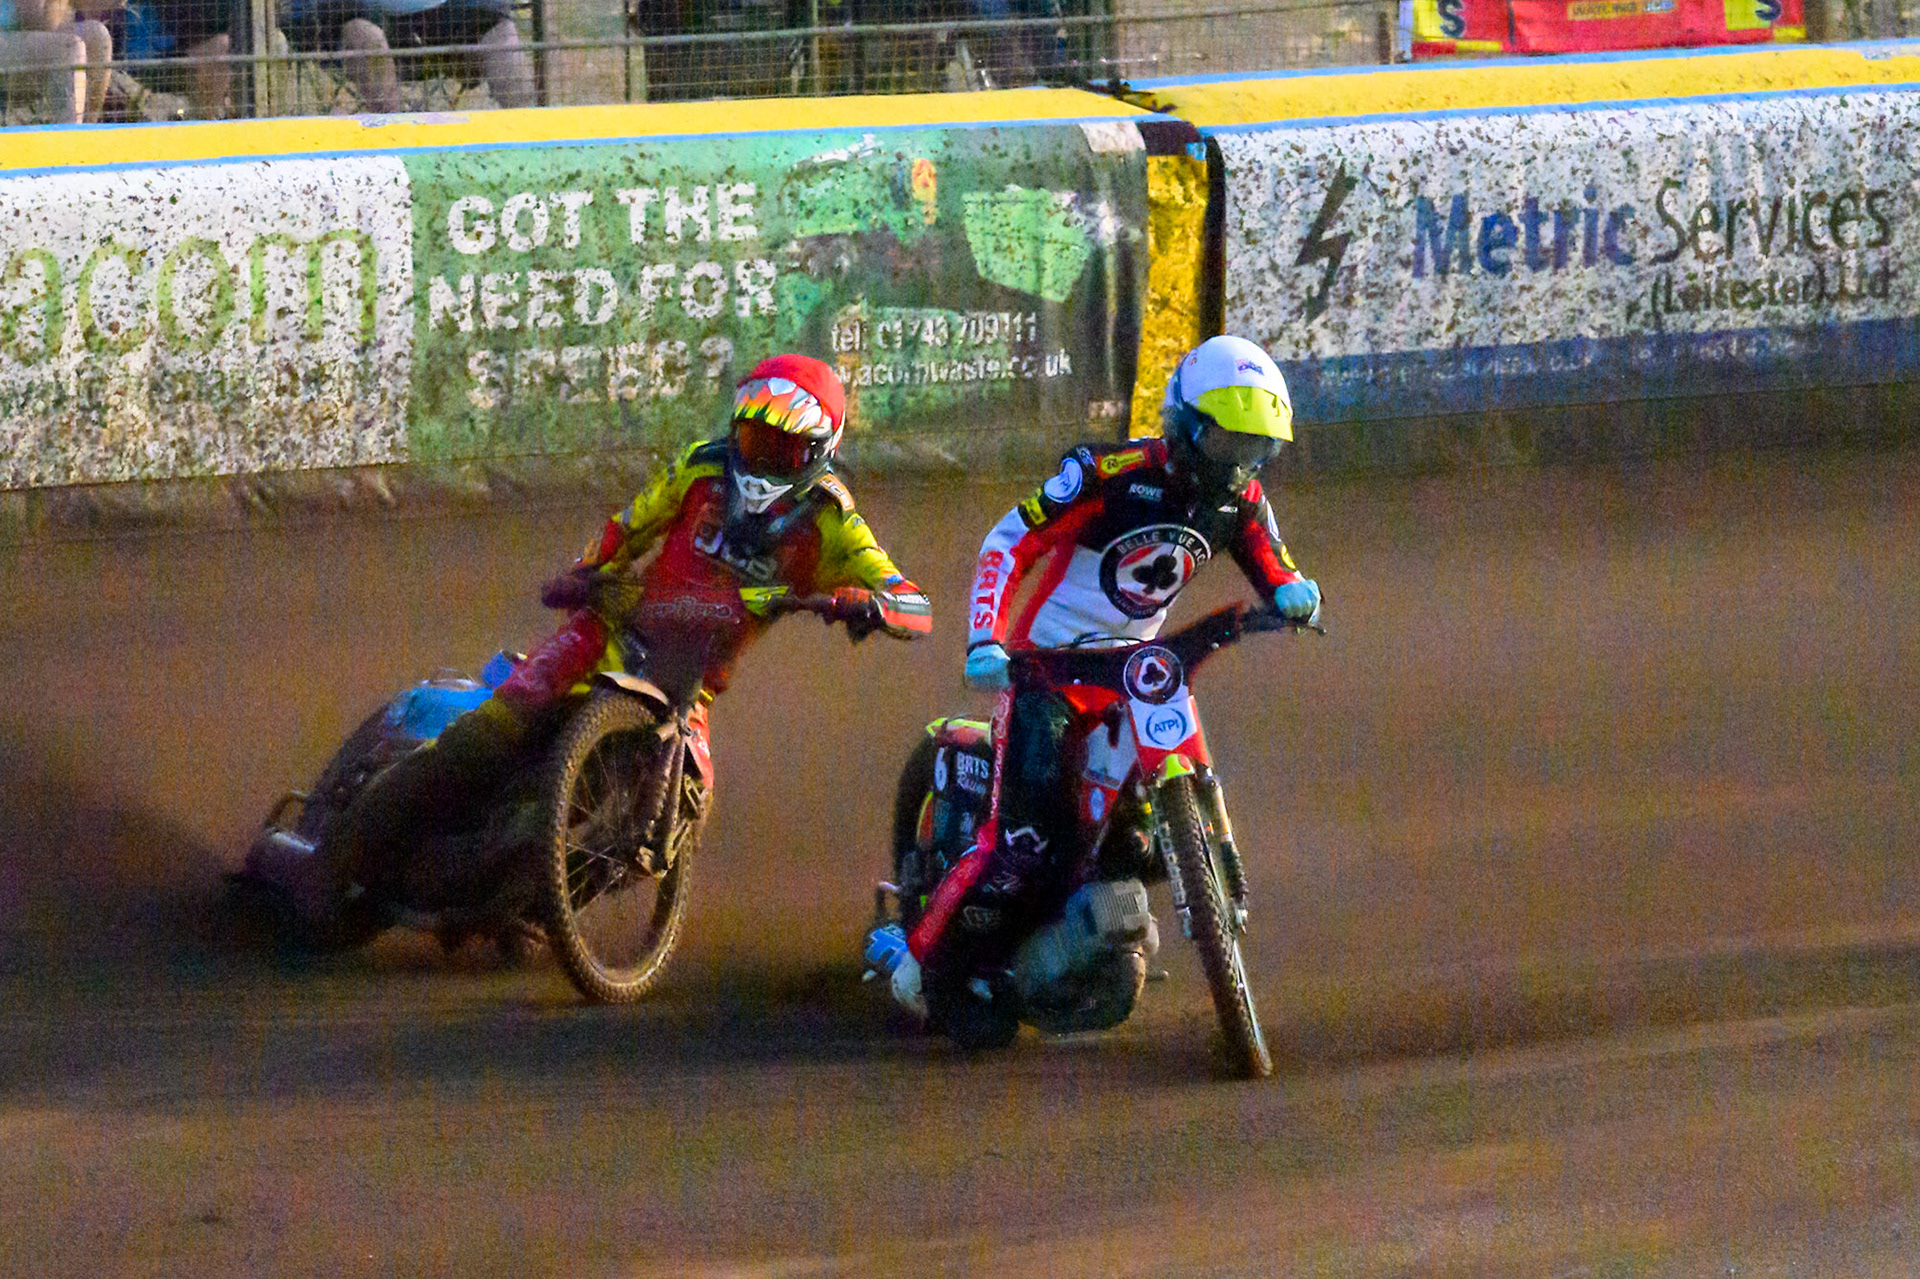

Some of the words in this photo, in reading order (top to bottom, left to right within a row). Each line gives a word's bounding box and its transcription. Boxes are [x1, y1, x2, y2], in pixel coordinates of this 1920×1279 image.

[447, 189, 594, 255] GOT
[616, 181, 758, 245] THE
[1411, 184, 1636, 279] Metric
[1648, 177, 1891, 264] Services
[429, 268, 618, 332] NEED
[639, 259, 779, 322] FOR
[1128, 483, 1164, 500] ROWE
[1153, 718, 1181, 734] ATPI
[934, 746, 948, 792] 6
[956, 751, 990, 780] BRTS
